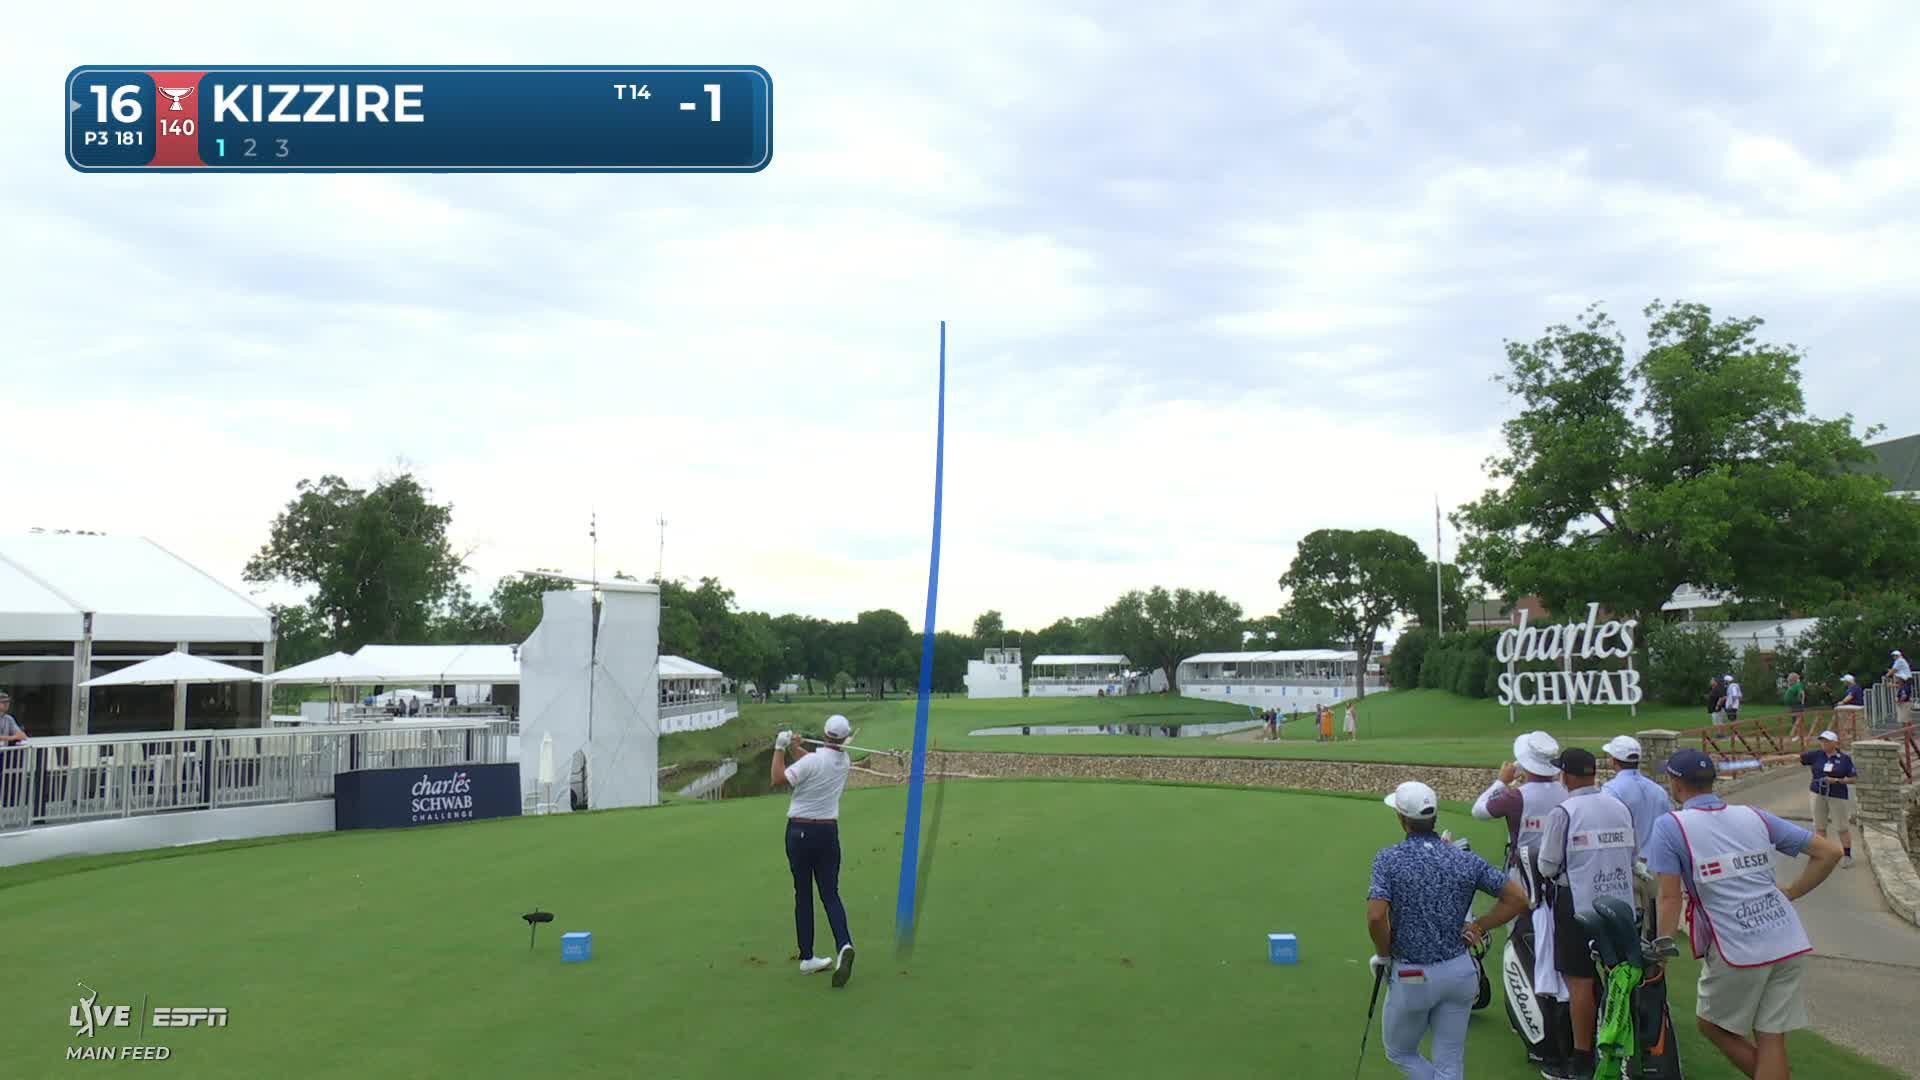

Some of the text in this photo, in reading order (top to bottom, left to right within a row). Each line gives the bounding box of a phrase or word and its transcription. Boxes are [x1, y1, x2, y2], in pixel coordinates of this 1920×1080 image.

[1496, 602, 1638, 663] charles
[1497, 669, 1643, 706] SCHWAB
[412, 772, 471, 795] charles
[412, 796, 473, 812] SCHWAB
[412, 810, 473, 822] CHALLENGE
[1598, 831, 1624, 843] KIZZIRE
[1733, 852, 1769, 870] OLESEN
[1736, 893, 1781, 920] charles
[1738, 906, 1786, 929] SCHWAB
[1505, 960, 1541, 1036] Titleist
